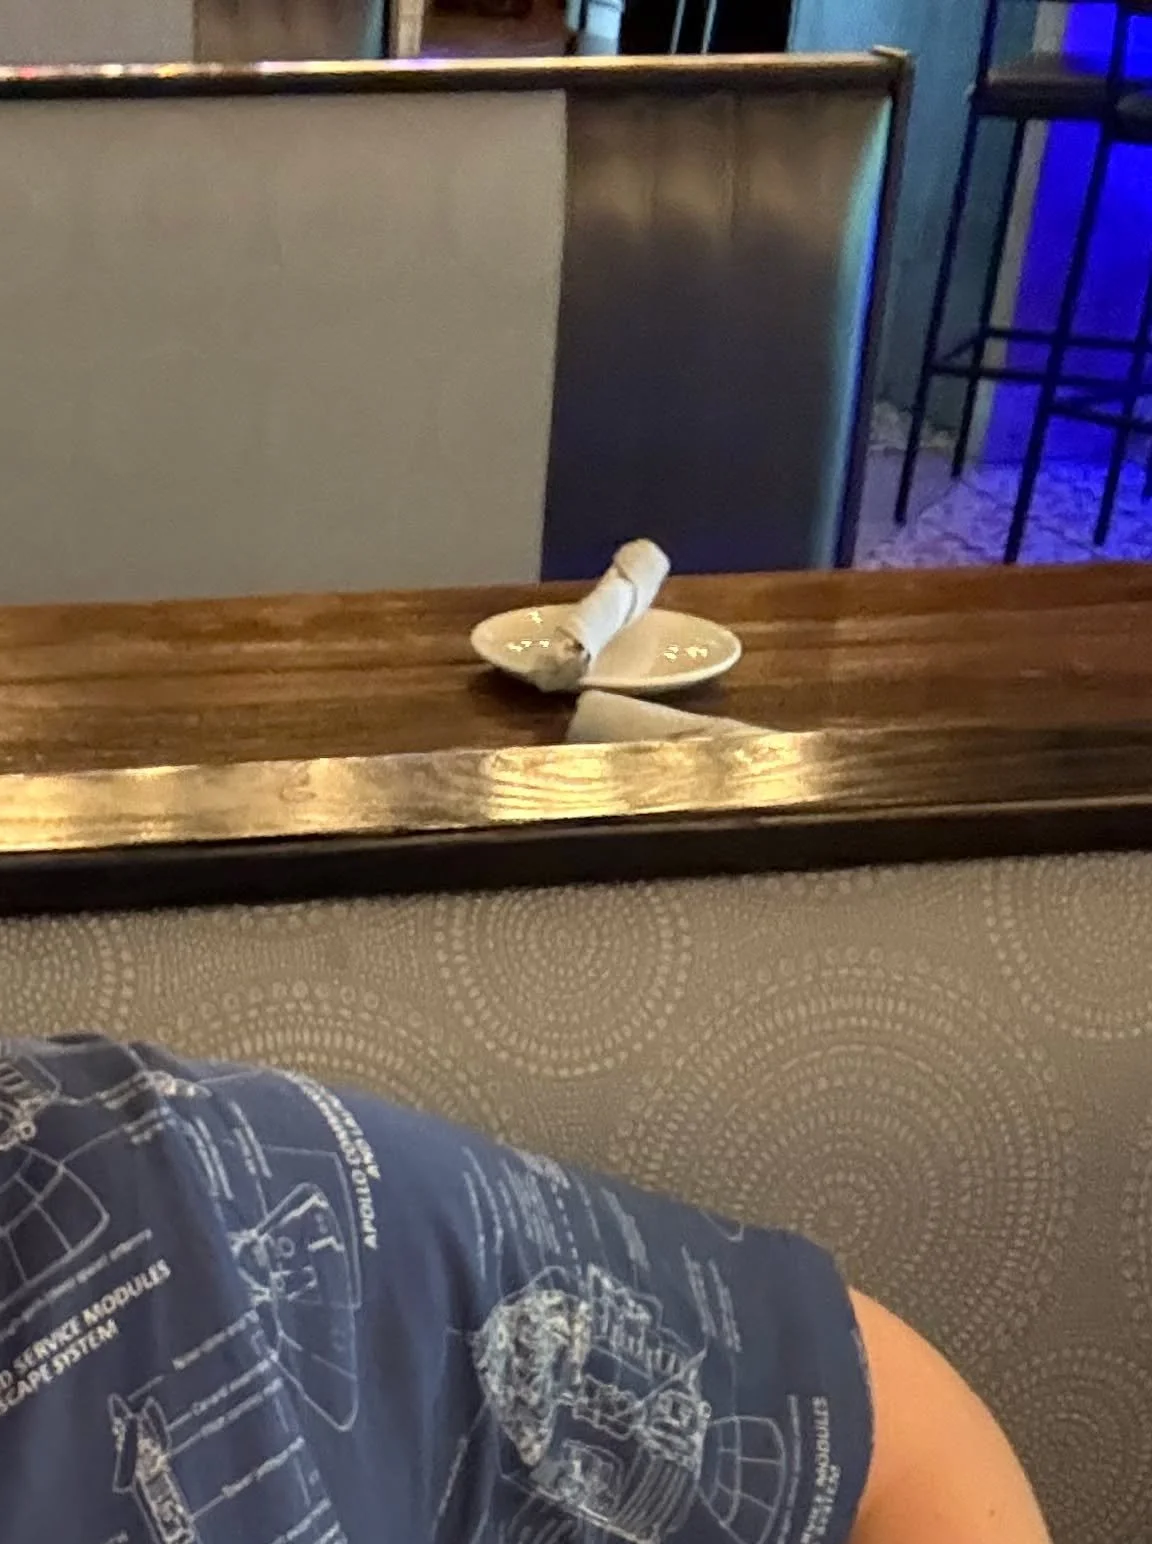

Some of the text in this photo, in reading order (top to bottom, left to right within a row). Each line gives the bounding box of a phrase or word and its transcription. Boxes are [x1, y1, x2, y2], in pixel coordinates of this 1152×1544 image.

[13, 1315, 82, 1373] SERVICE
[82, 1259, 171, 1326] MODULES
[51, 1318, 119, 1376] SYSTEM
